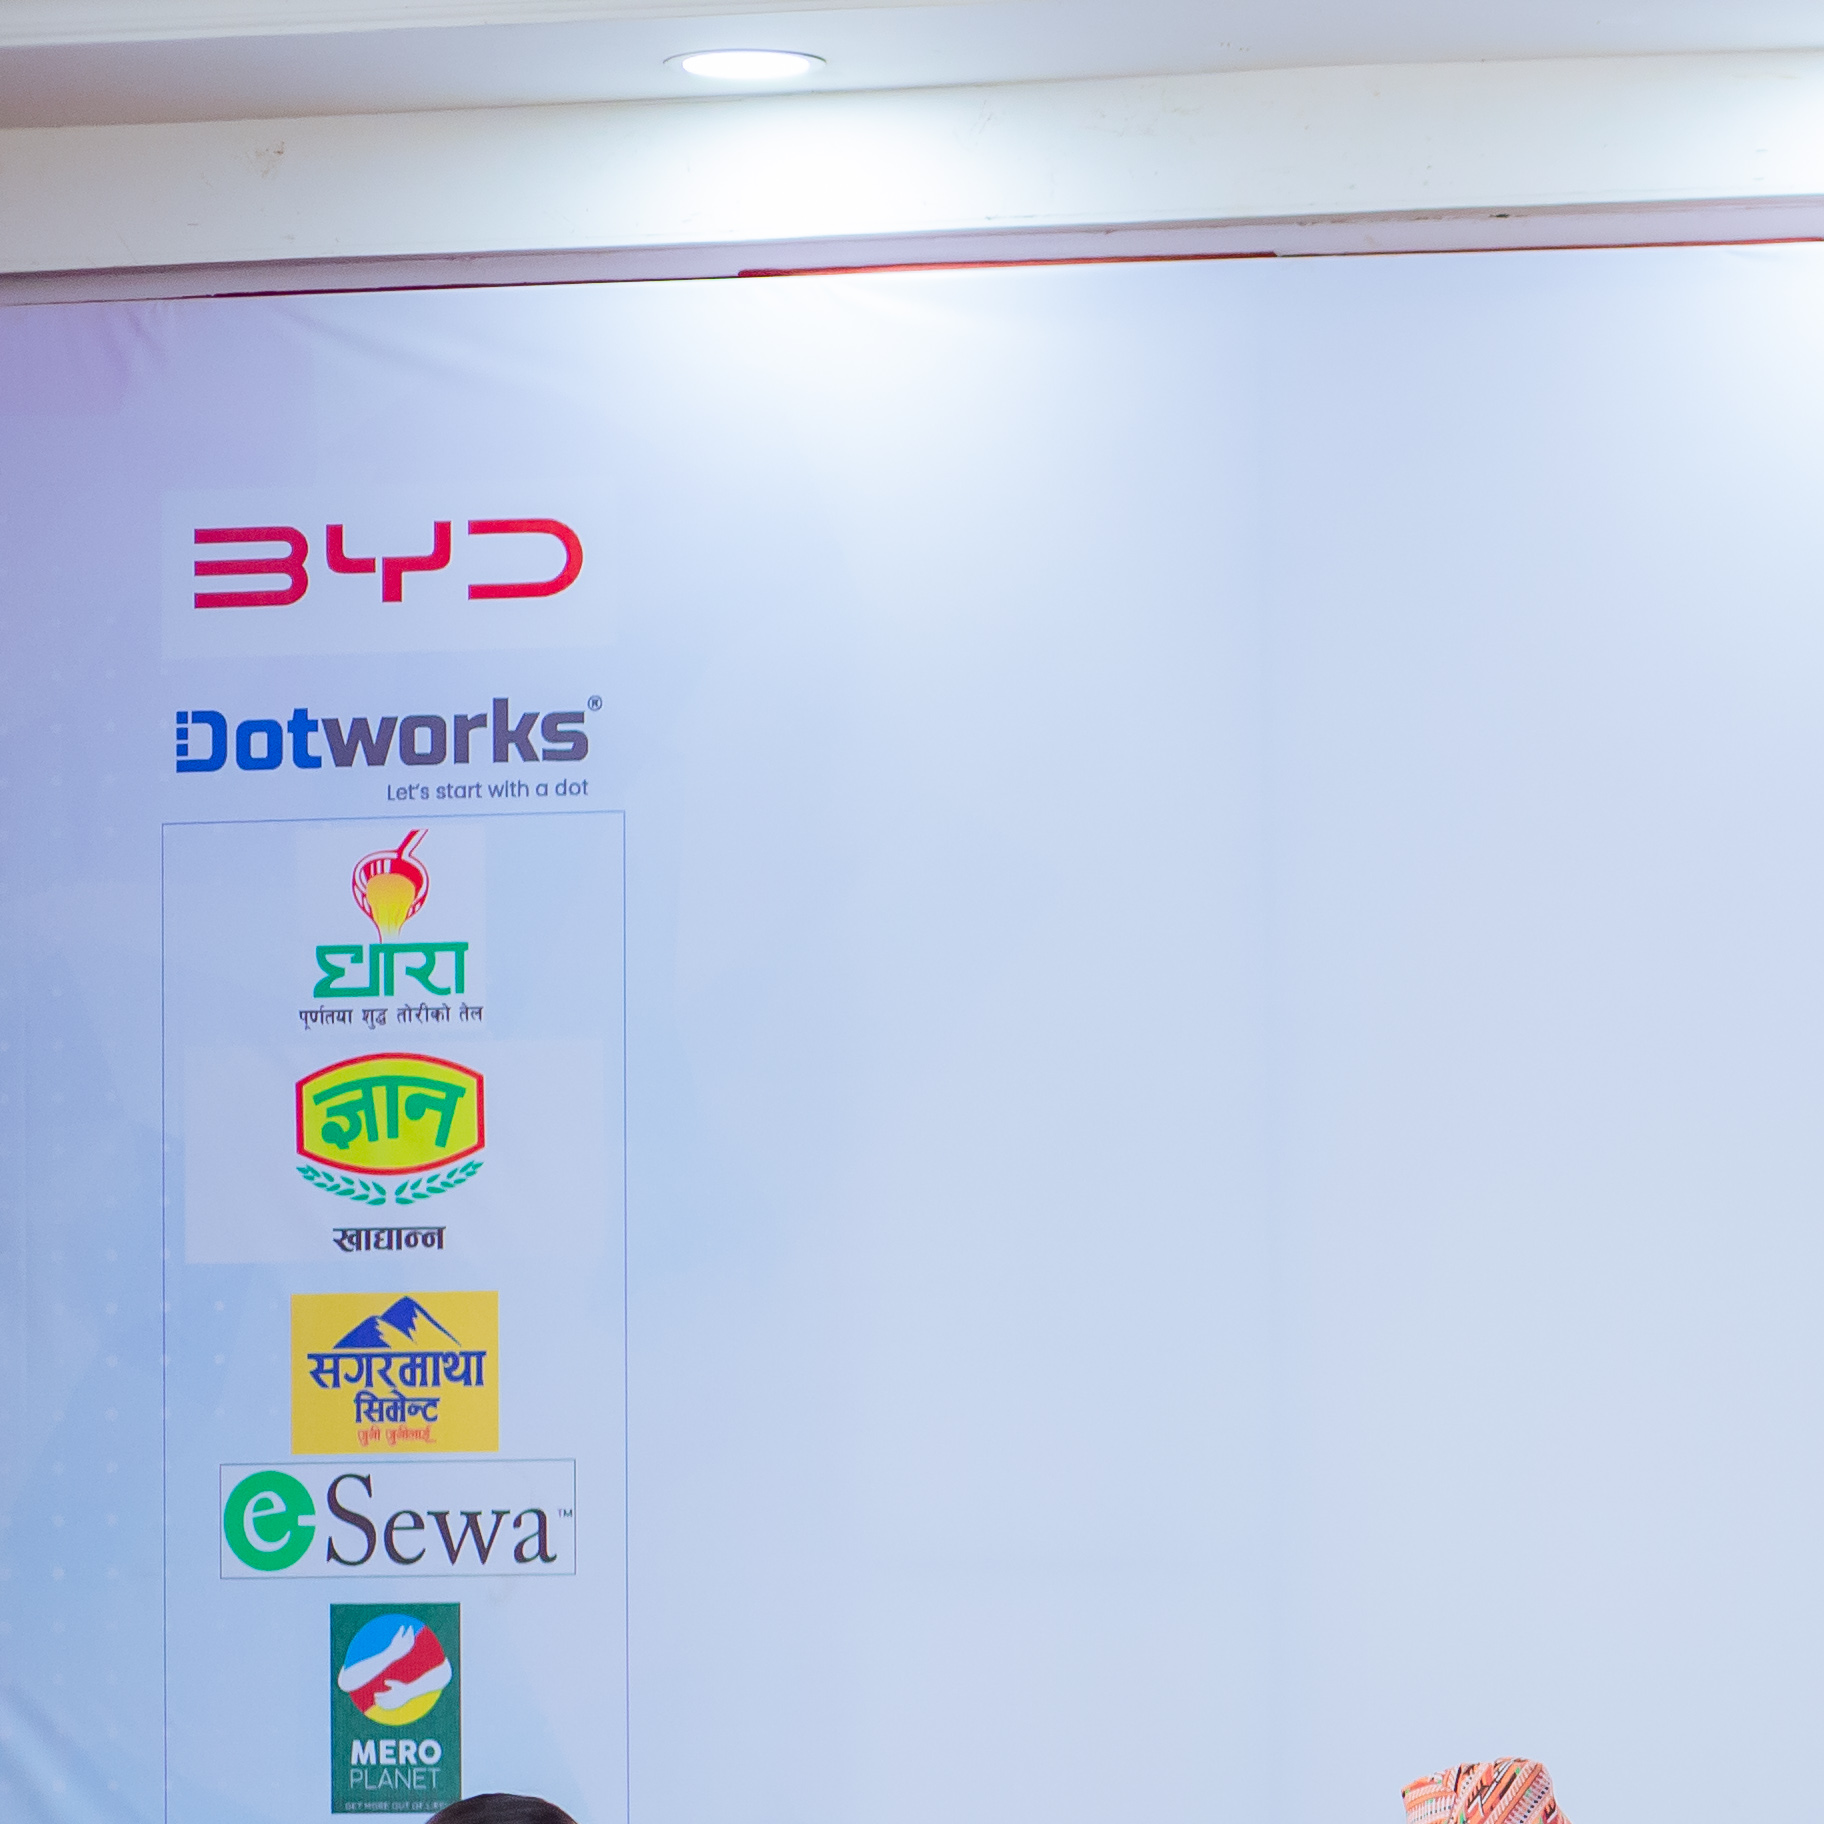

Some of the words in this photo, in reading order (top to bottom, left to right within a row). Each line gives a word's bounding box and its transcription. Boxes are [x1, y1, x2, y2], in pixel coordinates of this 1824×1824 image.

[194, 518, 583, 609] BYD
[176, 697, 588, 773] Dotworks
[387, 781, 430, 801] Let's
[436, 780, 482, 800] start
[488, 779, 529, 799] with
[536, 782, 549, 797] a
[555, 778, 589, 798] dot
[313, 941, 469, 999] धारा
[459, 1001, 484, 1023] तेल
[312, 1074, 467, 1151] ज्ञान
[307, 1351, 487, 1389] सगरमाथा
[350, 1738, 442, 1766] MERO
[350, 1767, 441, 1790] PLANET
